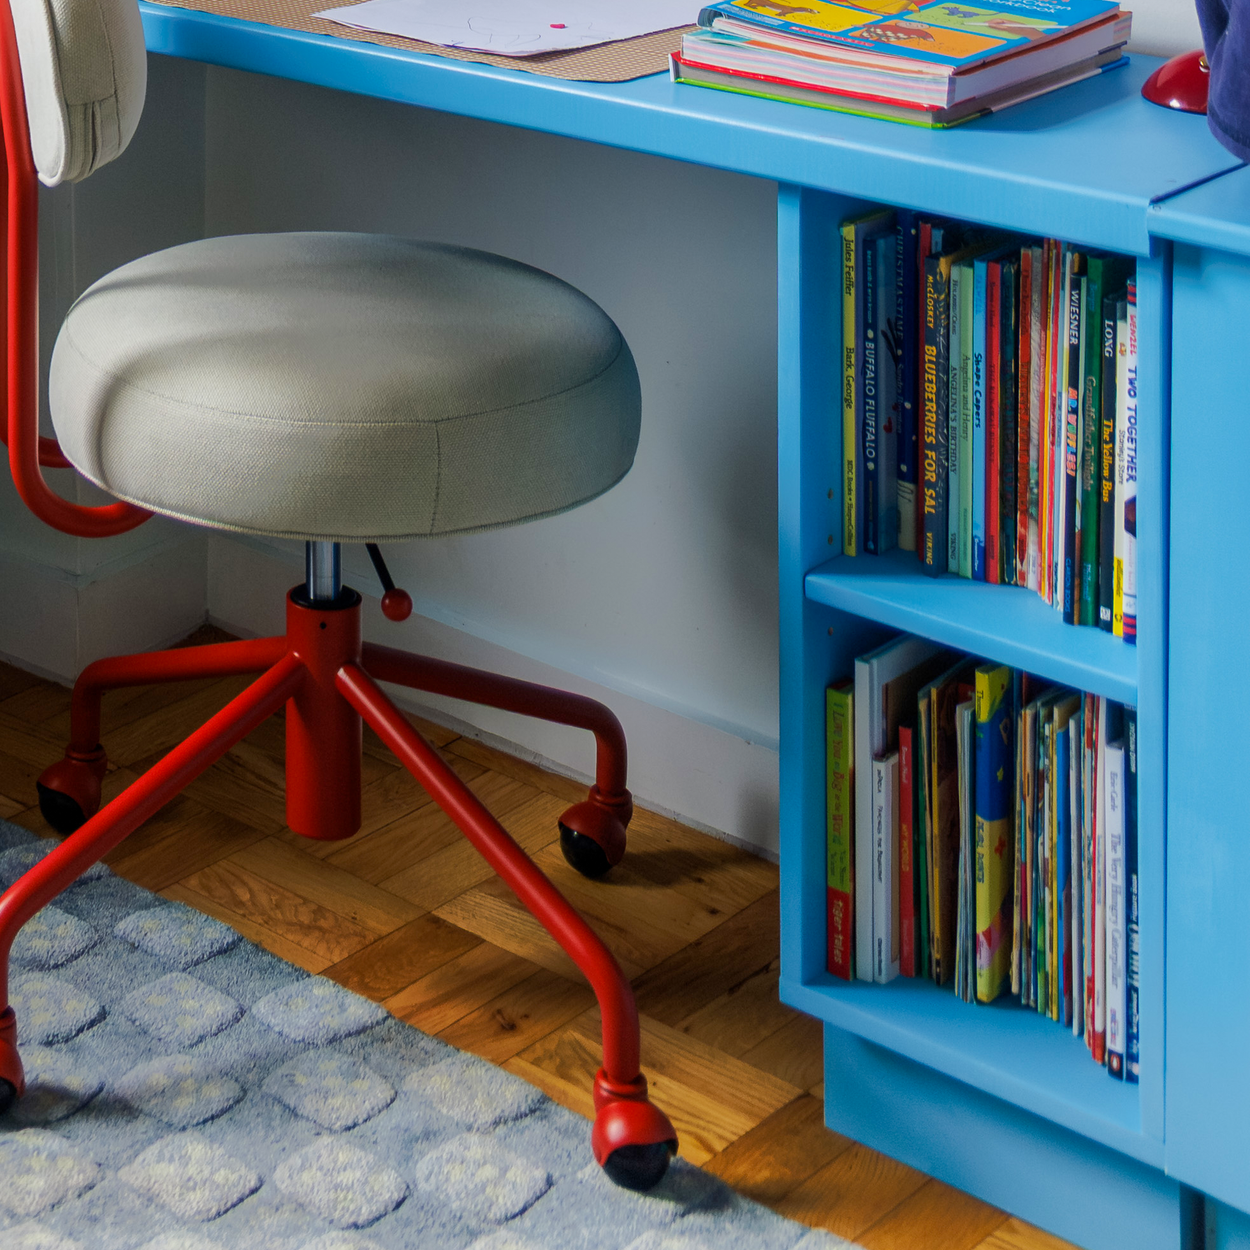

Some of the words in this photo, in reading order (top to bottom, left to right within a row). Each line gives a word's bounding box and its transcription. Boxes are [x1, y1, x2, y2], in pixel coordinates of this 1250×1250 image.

[844, 238, 854, 263] Jules
[844, 264, 854, 296] Feiffer
[926, 274, 935, 329] McCLOSKEY
[1070, 290, 1080, 345] WIESNER
[1104, 319, 1114, 358] LONG
[1129, 314, 1137, 356] WENZEL
[865, 341, 875, 396] BUFFALO
[961, 354, 970, 393] Angelina
[974, 352, 983, 387] Shape
[1127, 366, 1138, 399] TWO
[844, 375, 855, 409] George
[924, 345, 937, 444] BLUEBERRIES
[950, 365, 958, 422] ANGELINA'S
[962, 394, 970, 411] and
[973, 389, 982, 428] Capers
[1068, 387, 1078, 411] MR.
[864, 398, 876, 459] FLUFFALO
[961, 413, 971, 442] Henry
[1103, 418, 1113, 442] The
[1126, 404, 1138, 483] TOGETHER
[950, 425, 958, 475] BIRTHDAY
[1102, 443, 1113, 479] Yellow
[1116, 429, 1125, 463] Stanley's
[924, 449, 937, 483] FOR
[1117, 464, 1125, 485] Store
[924, 487, 937, 514] SAL
[1102, 480, 1112, 502] Bus
[925, 532, 933, 565] VIKING
[1110, 771, 1119, 790] Eric
[1110, 791, 1119, 812] Carle
[1110, 833, 1121, 855] The
[832, 900, 843, 931] tiger
[1108, 883, 1122, 927] Hungry
[833, 934, 844, 965] tales
